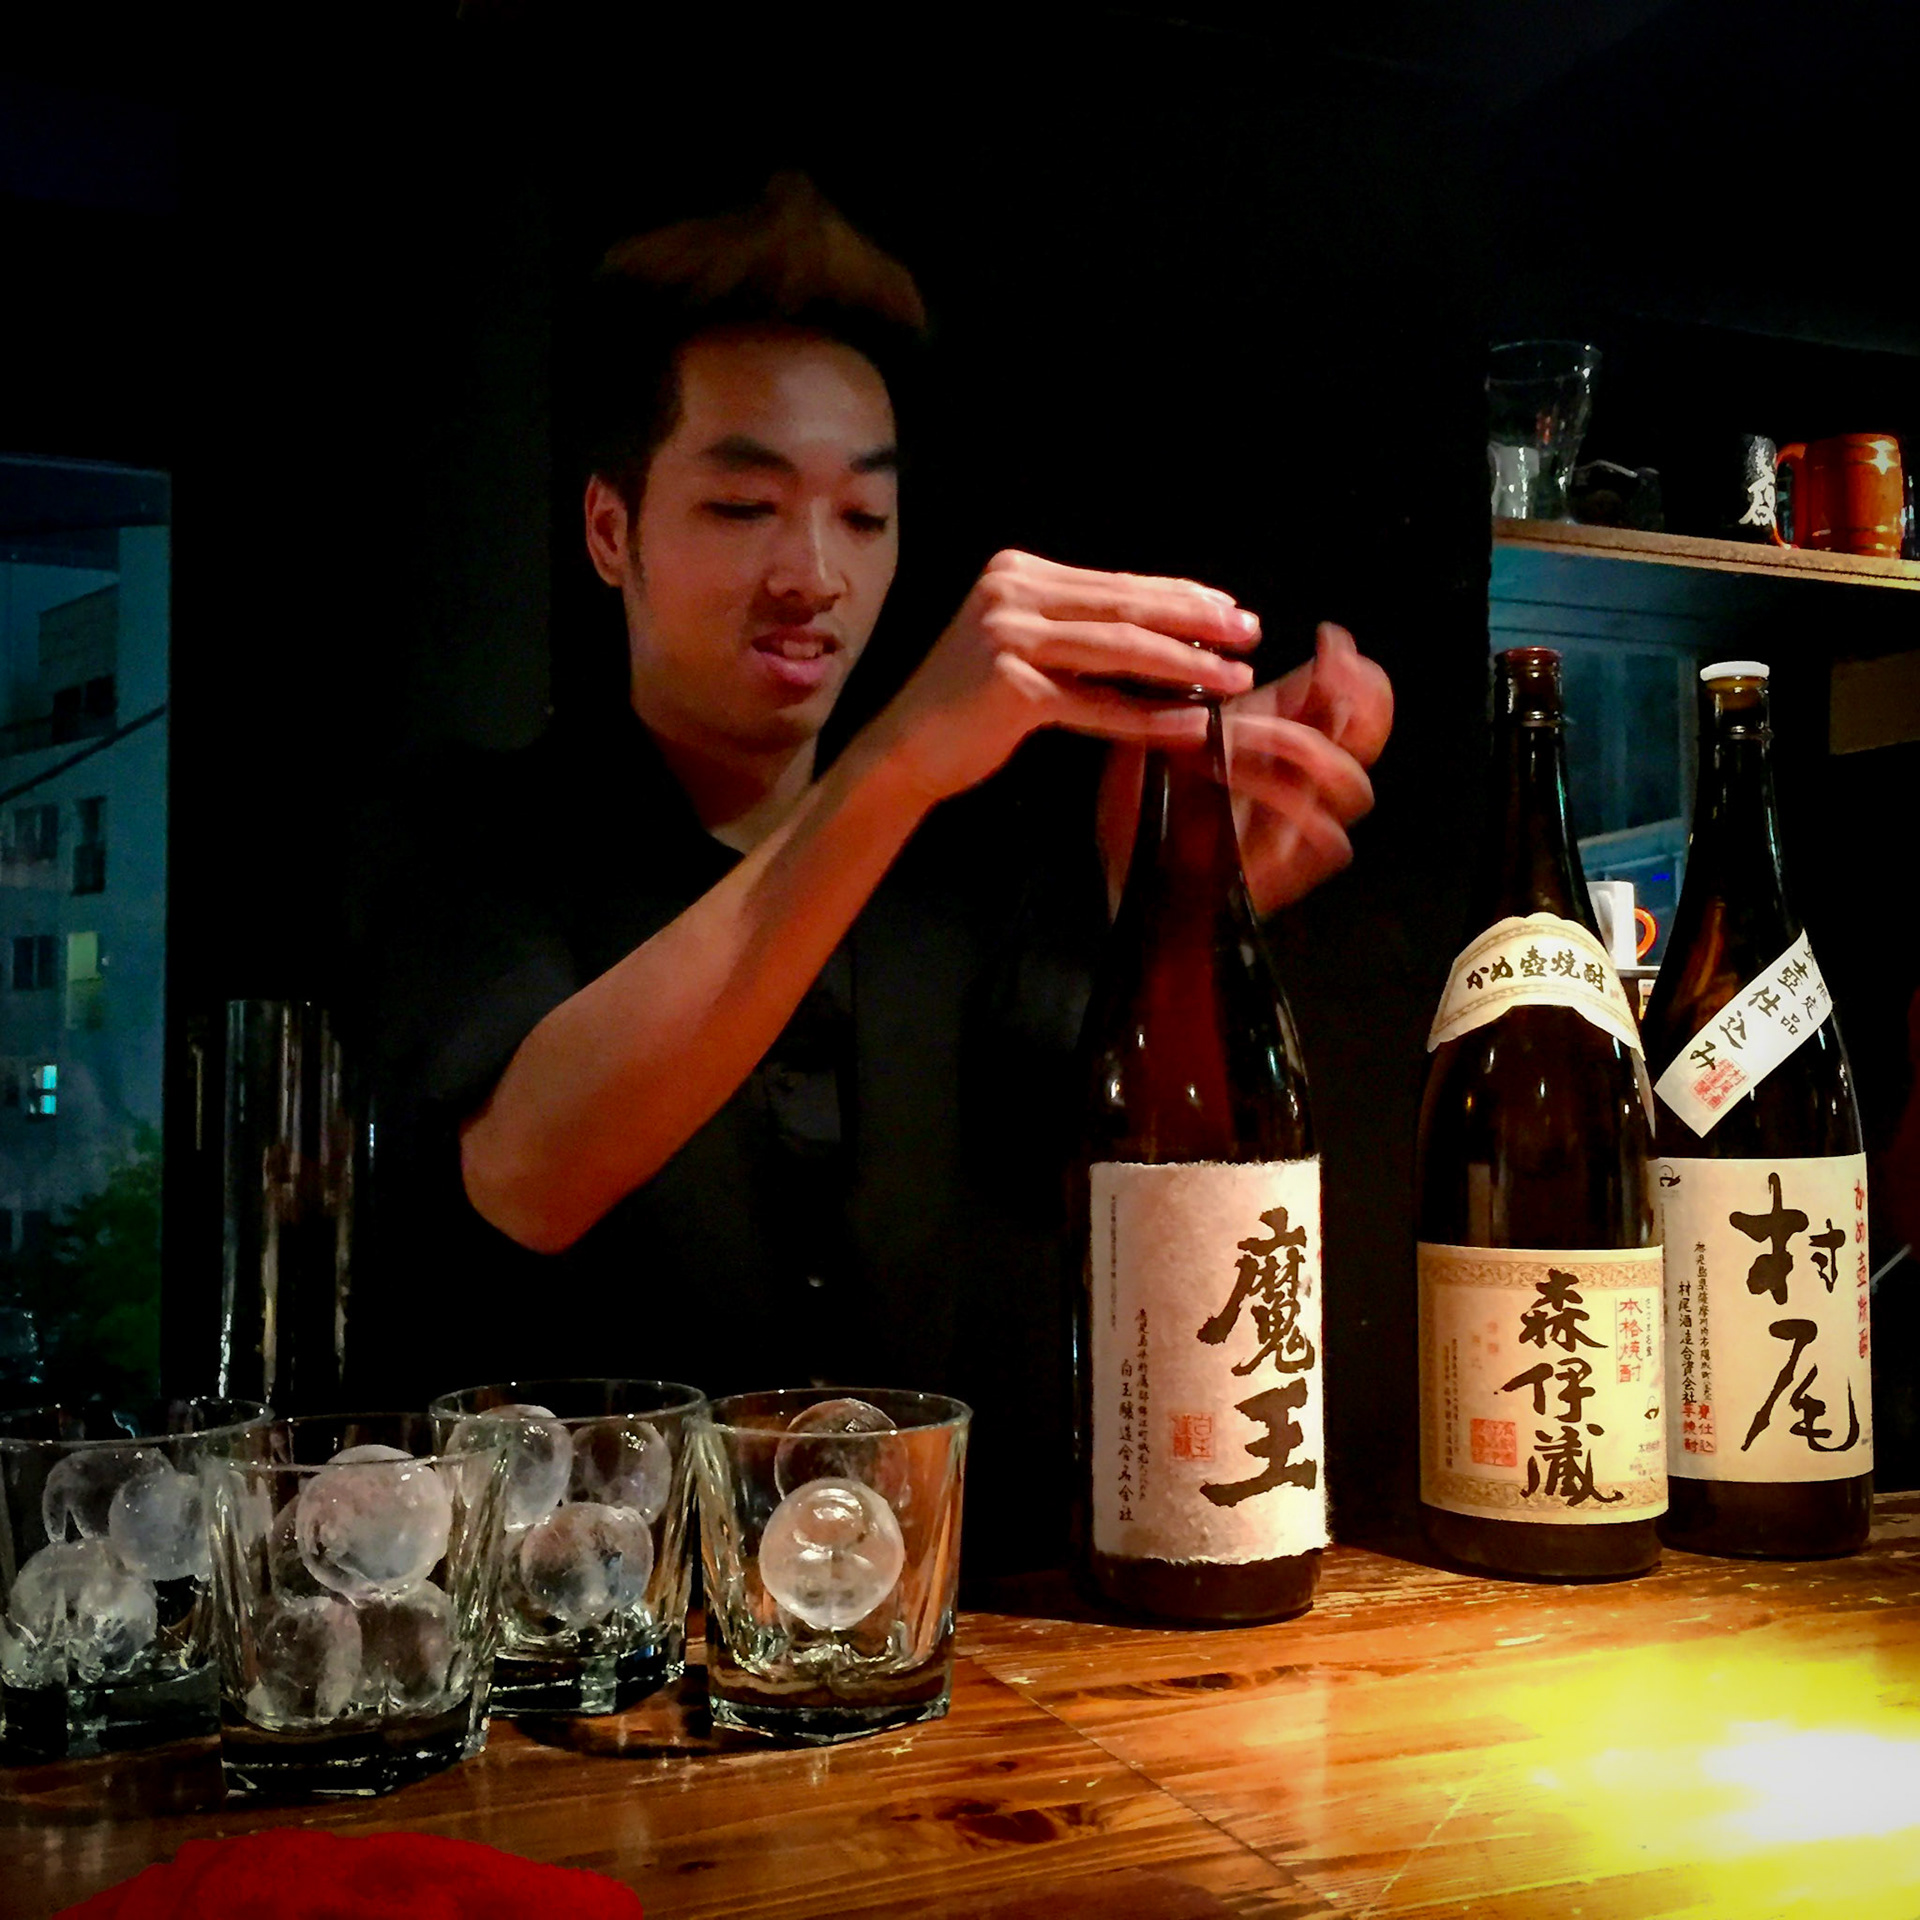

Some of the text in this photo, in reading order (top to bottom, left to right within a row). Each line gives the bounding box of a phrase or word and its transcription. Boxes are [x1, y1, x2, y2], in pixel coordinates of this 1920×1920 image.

[1466, 945, 1606, 993] かめ壺焼酎
[1197, 1206, 1318, 1508] 魔王
[1494, 1267, 1624, 1507] 森伊蔵
[1729, 1171, 1860, 1452] 村尾
